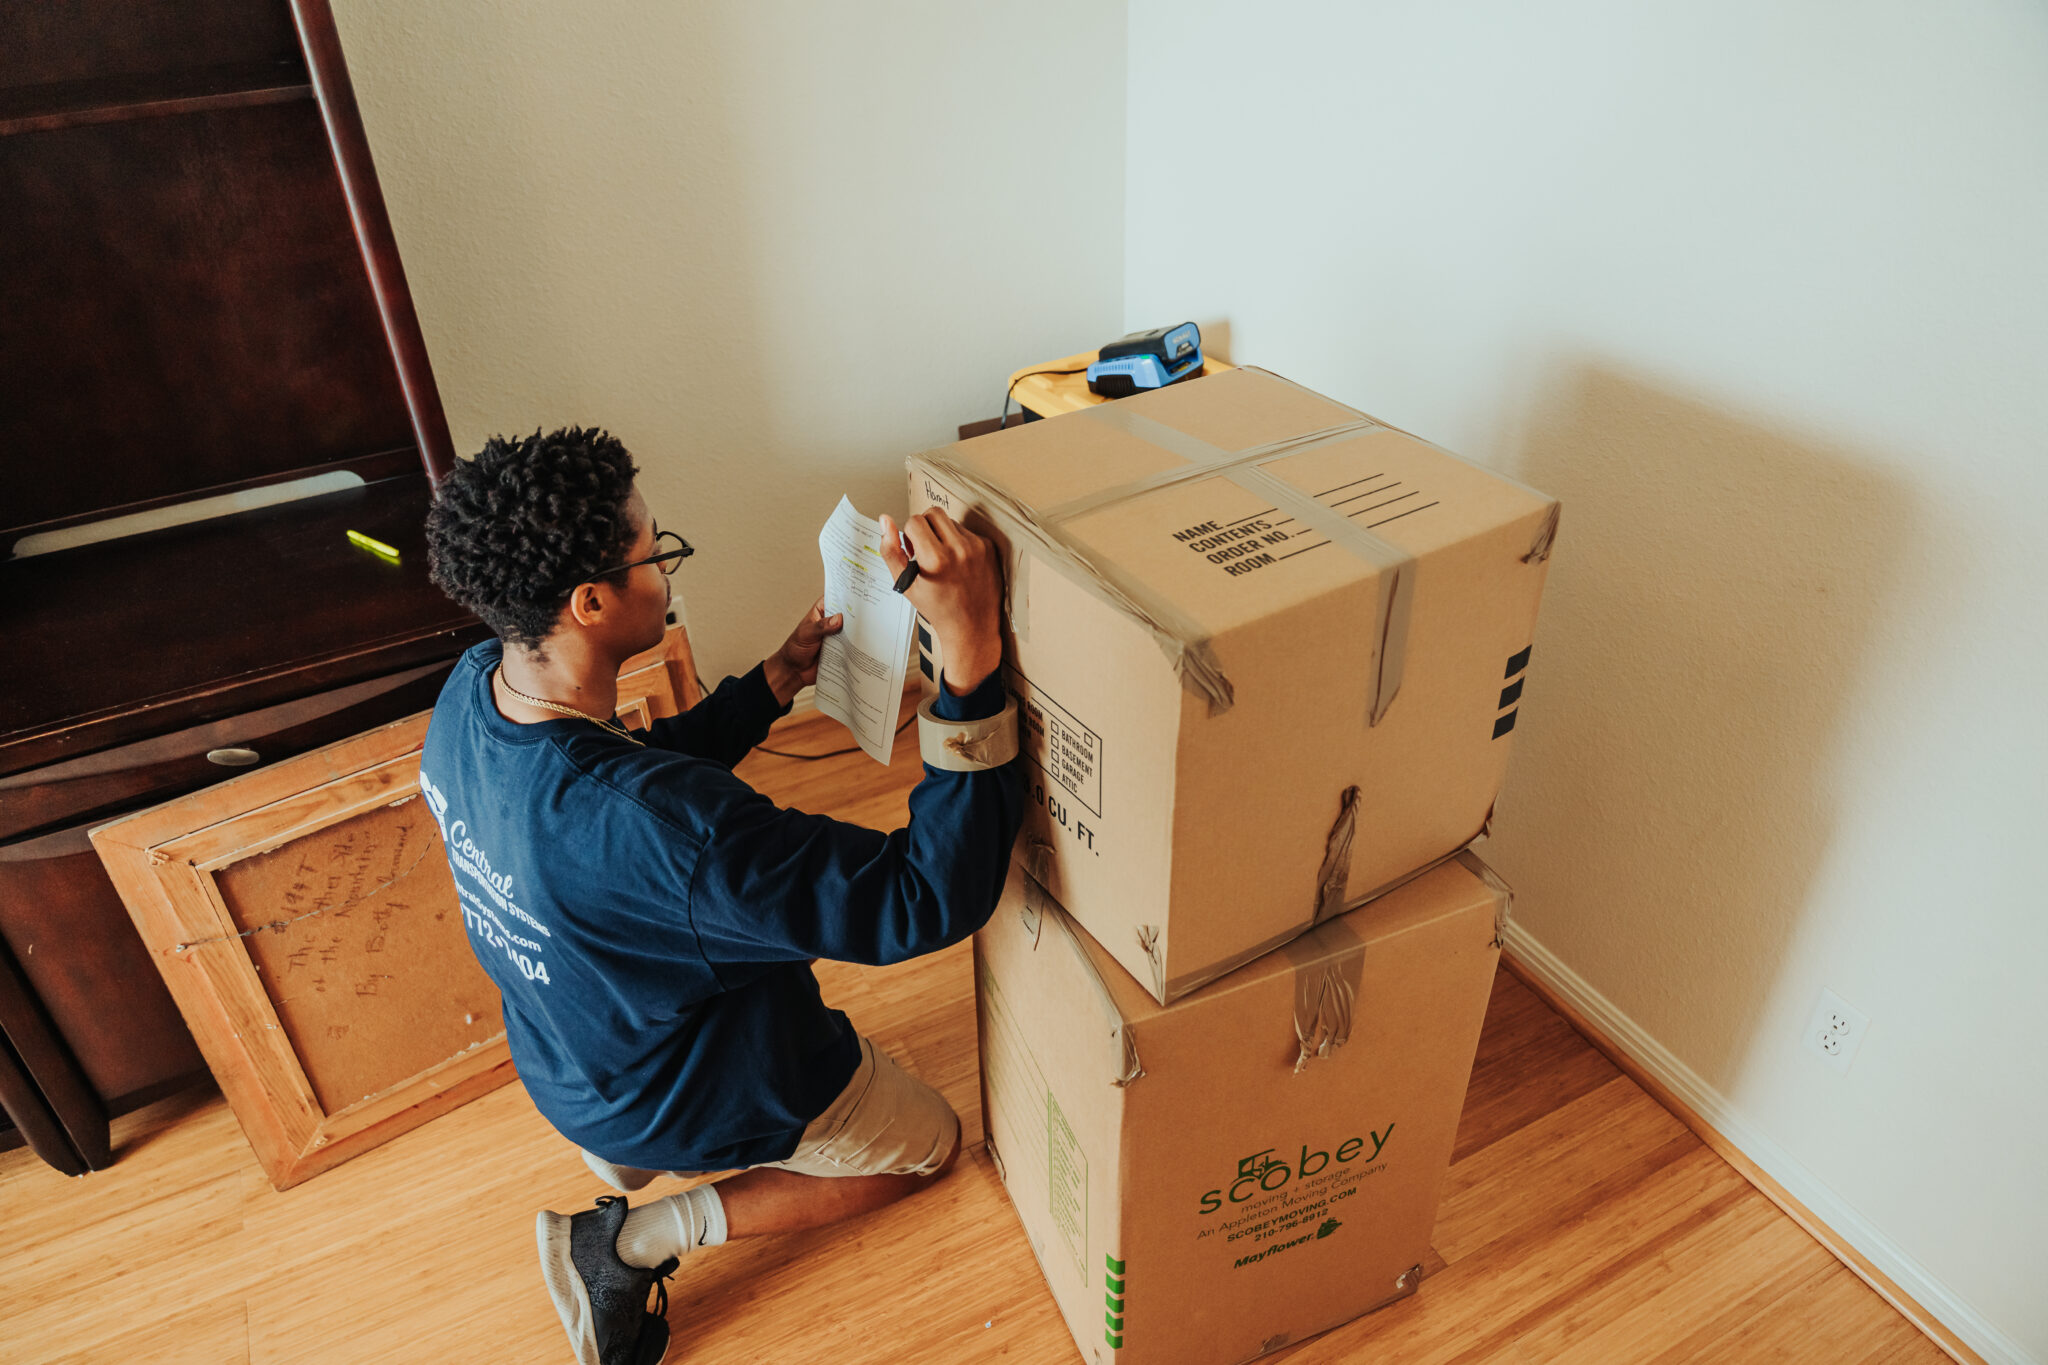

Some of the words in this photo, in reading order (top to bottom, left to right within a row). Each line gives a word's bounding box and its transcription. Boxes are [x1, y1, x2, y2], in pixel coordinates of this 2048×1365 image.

[1172, 520, 1224, 543] NAME
[1188, 519, 1273, 553] CONTENTS
[1206, 540, 1265, 565] ORDER
[1260, 530, 1295, 545] NO.
[1223, 553, 1277, 577] ROOM
[1027, 701, 1043, 722] ROOM
[1029, 716, 1045, 738] ROOM
[1061, 728, 1094, 764] BATHROOM
[1061, 744, 1094, 778] BASEMENT
[1061, 758, 1085, 785] GARAGE
[1061, 773, 1078, 793] ATTIC
[1048, 795, 1072, 832] CU.
[1077, 820, 1099, 857] FT.
[450, 820, 514, 899] Central
[507, 901, 551, 937] SYSTEMS
[355, 973, 395, 998] By
[1197, 1229, 1216, 1241] An
[1219, 1205, 1279, 1232] Appleton
[1281, 1186, 1328, 1209] Moving
[1330, 1162, 1389, 1190] Company
[1241, 1191, 1289, 1214] moving
[1304, 1167, 1351, 1190] storage
[1227, 1187, 1358, 1242] SCOBEYMOVING.COM
